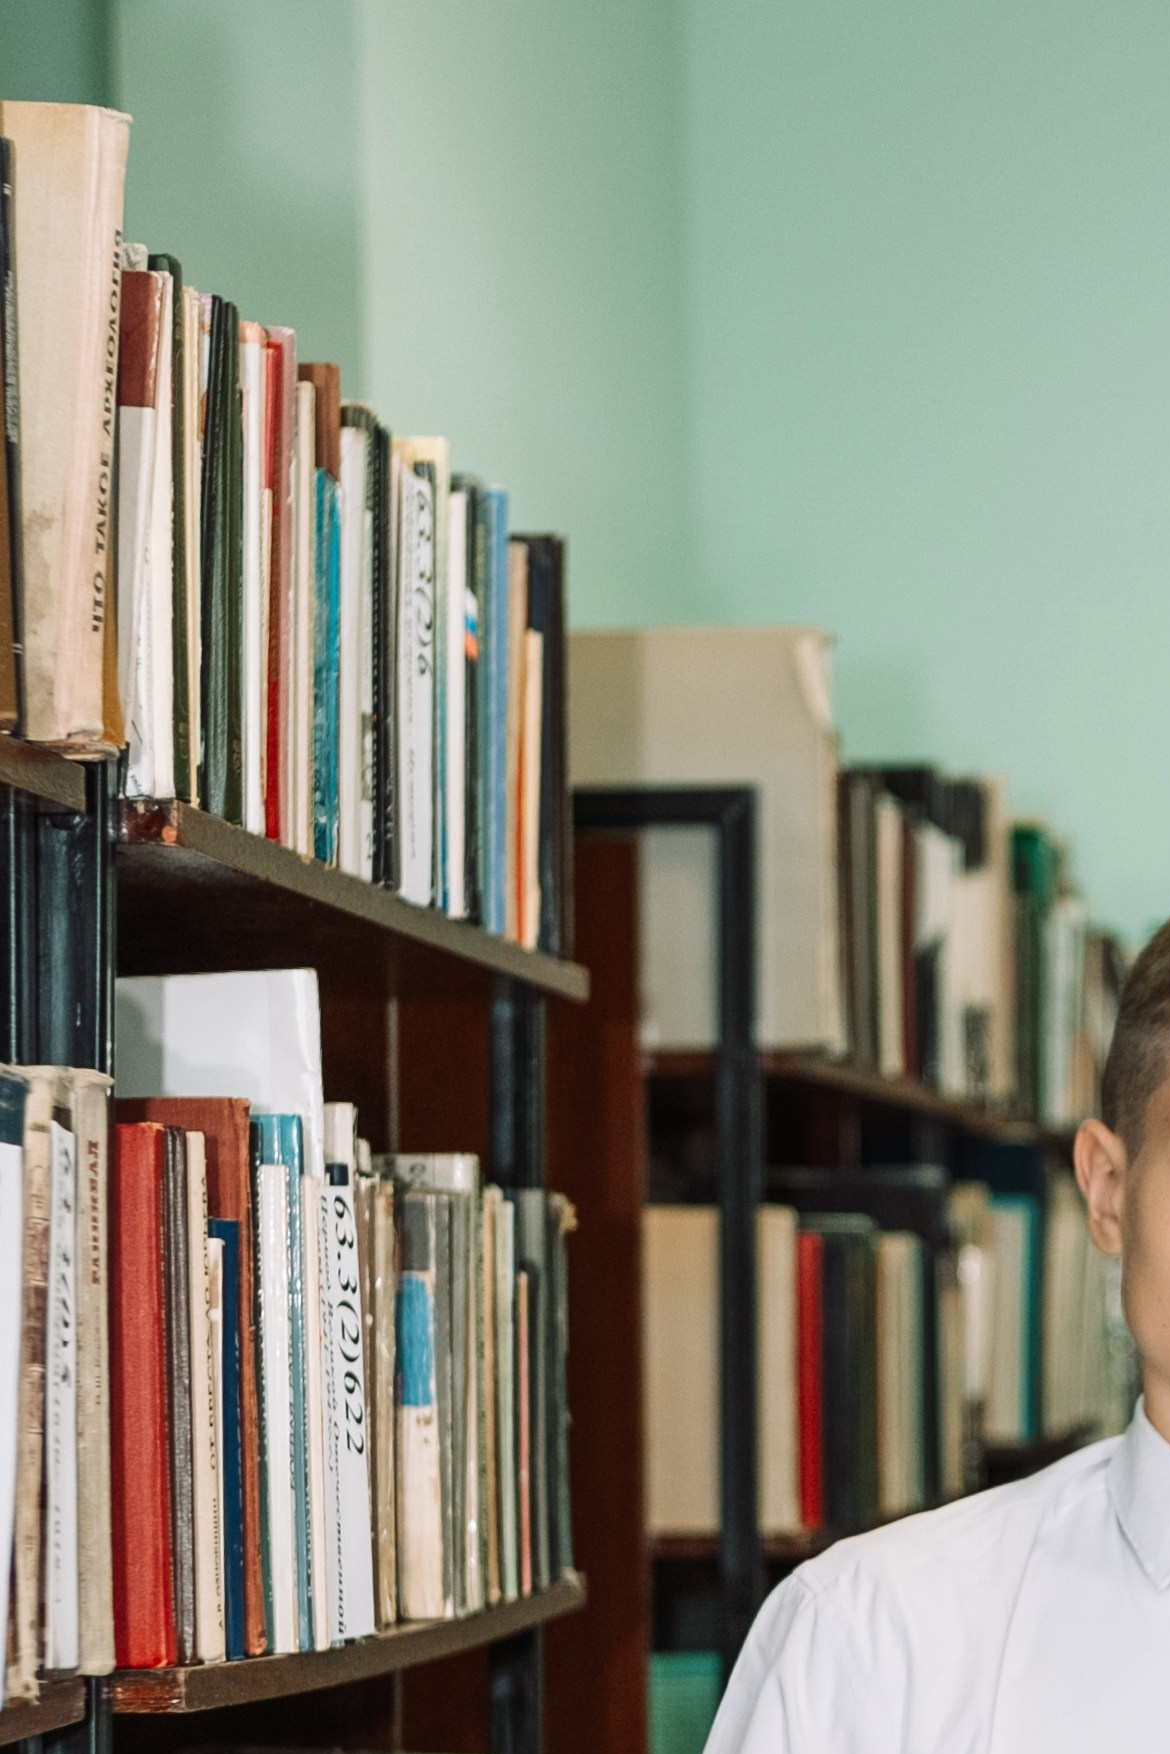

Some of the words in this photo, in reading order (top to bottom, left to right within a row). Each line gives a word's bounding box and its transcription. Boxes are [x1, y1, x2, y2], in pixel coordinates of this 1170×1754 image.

[102, 228, 121, 438] АРХЕОЛОГИЯ
[94, 451, 110, 556] ТАКОЕ
[91, 570, 104, 633] ЧТО
[333, 1195, 365, 1456] 63.3(2)622
[210, 1435, 216, 1471] ОТ
[320, 1194, 332, 1291] Период
[328, 1299, 338, 1411] Великой
[333, 1420, 347, 1636] Отечественной
